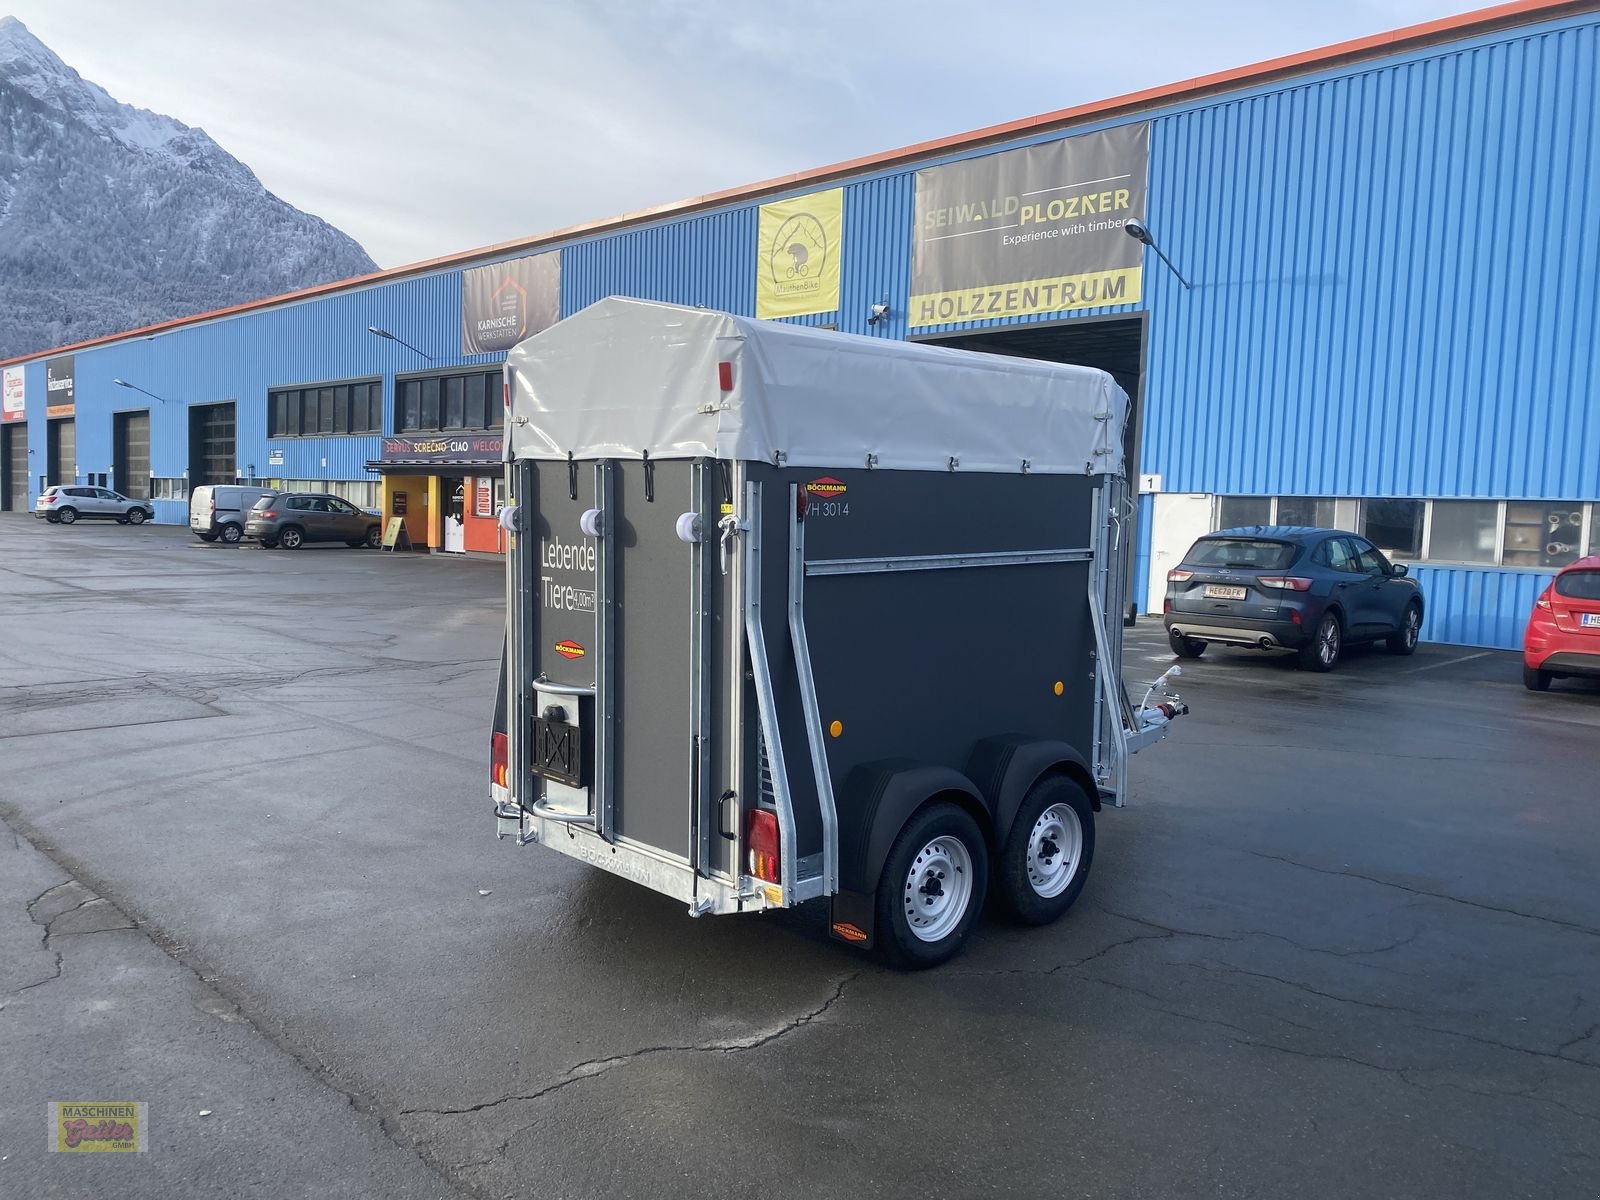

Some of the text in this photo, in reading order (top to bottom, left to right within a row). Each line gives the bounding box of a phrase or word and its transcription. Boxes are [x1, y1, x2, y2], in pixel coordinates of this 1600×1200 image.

[925, 196, 1019, 230] SEIWALD
[1002, 218, 1126, 246] Experience with timber
[920, 275, 1126, 321] HOLZZENTRUM
[477, 315, 517, 331] KARNISCHE
[450, 441, 468, 452] CIAO
[807, 483, 847, 492] BÖCKMANN
[1147, 477, 1153, 489] 1
[822, 502, 849, 516] 3014
[542, 535, 595, 572] Lebende
[541, 576, 574, 611] Tiere
[555, 644, 585, 656] BÖCKMANN
